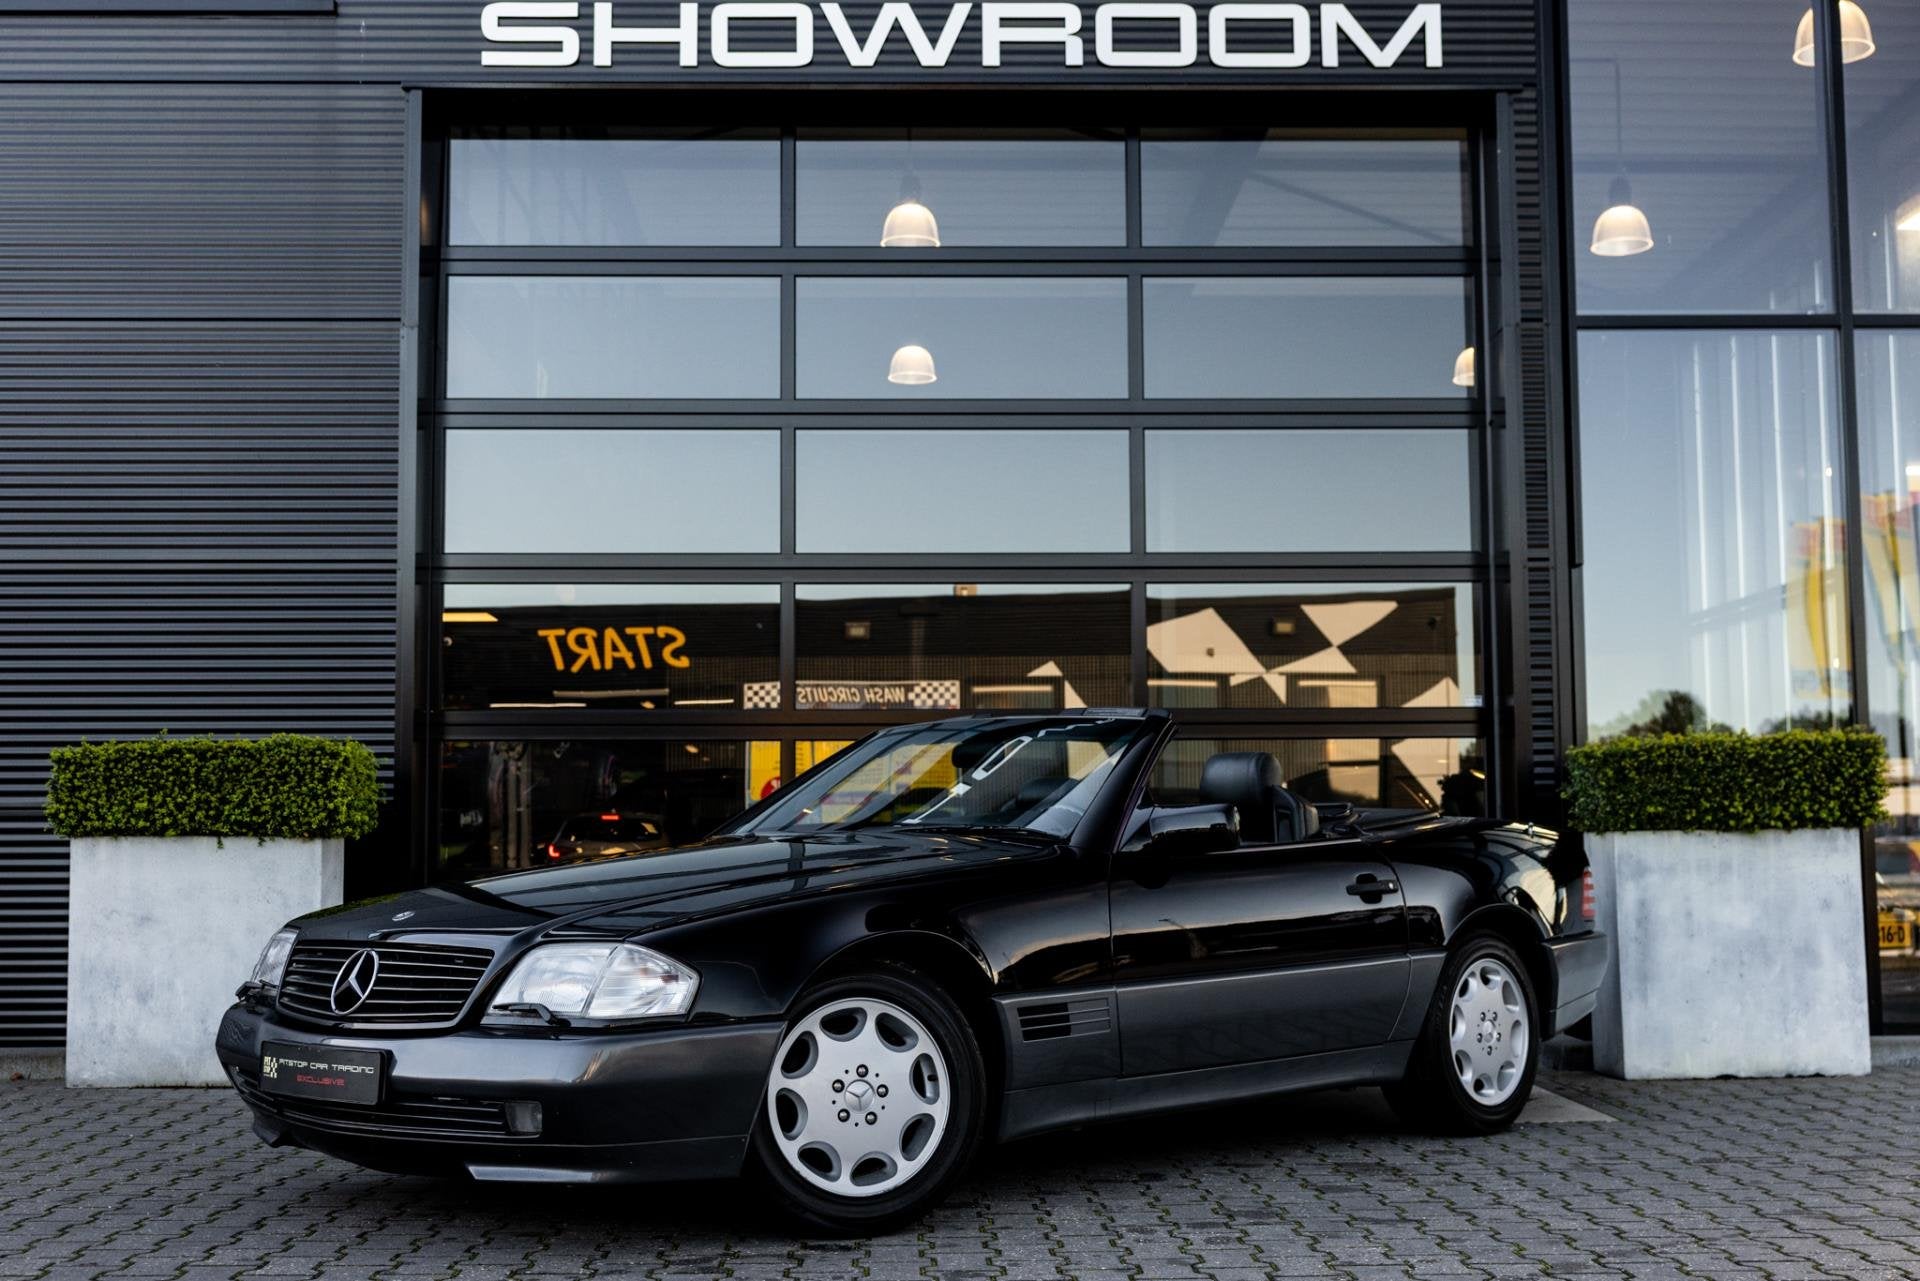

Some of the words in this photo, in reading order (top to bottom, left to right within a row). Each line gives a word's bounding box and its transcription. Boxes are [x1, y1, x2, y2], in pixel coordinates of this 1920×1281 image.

[481, 2, 1442, 68] SHOWROOM
[310, 1062, 328, 1070] CAR
[332, 1064, 374, 1074] TRADING
[296, 1074, 345, 1086] EXCLUSIVE
